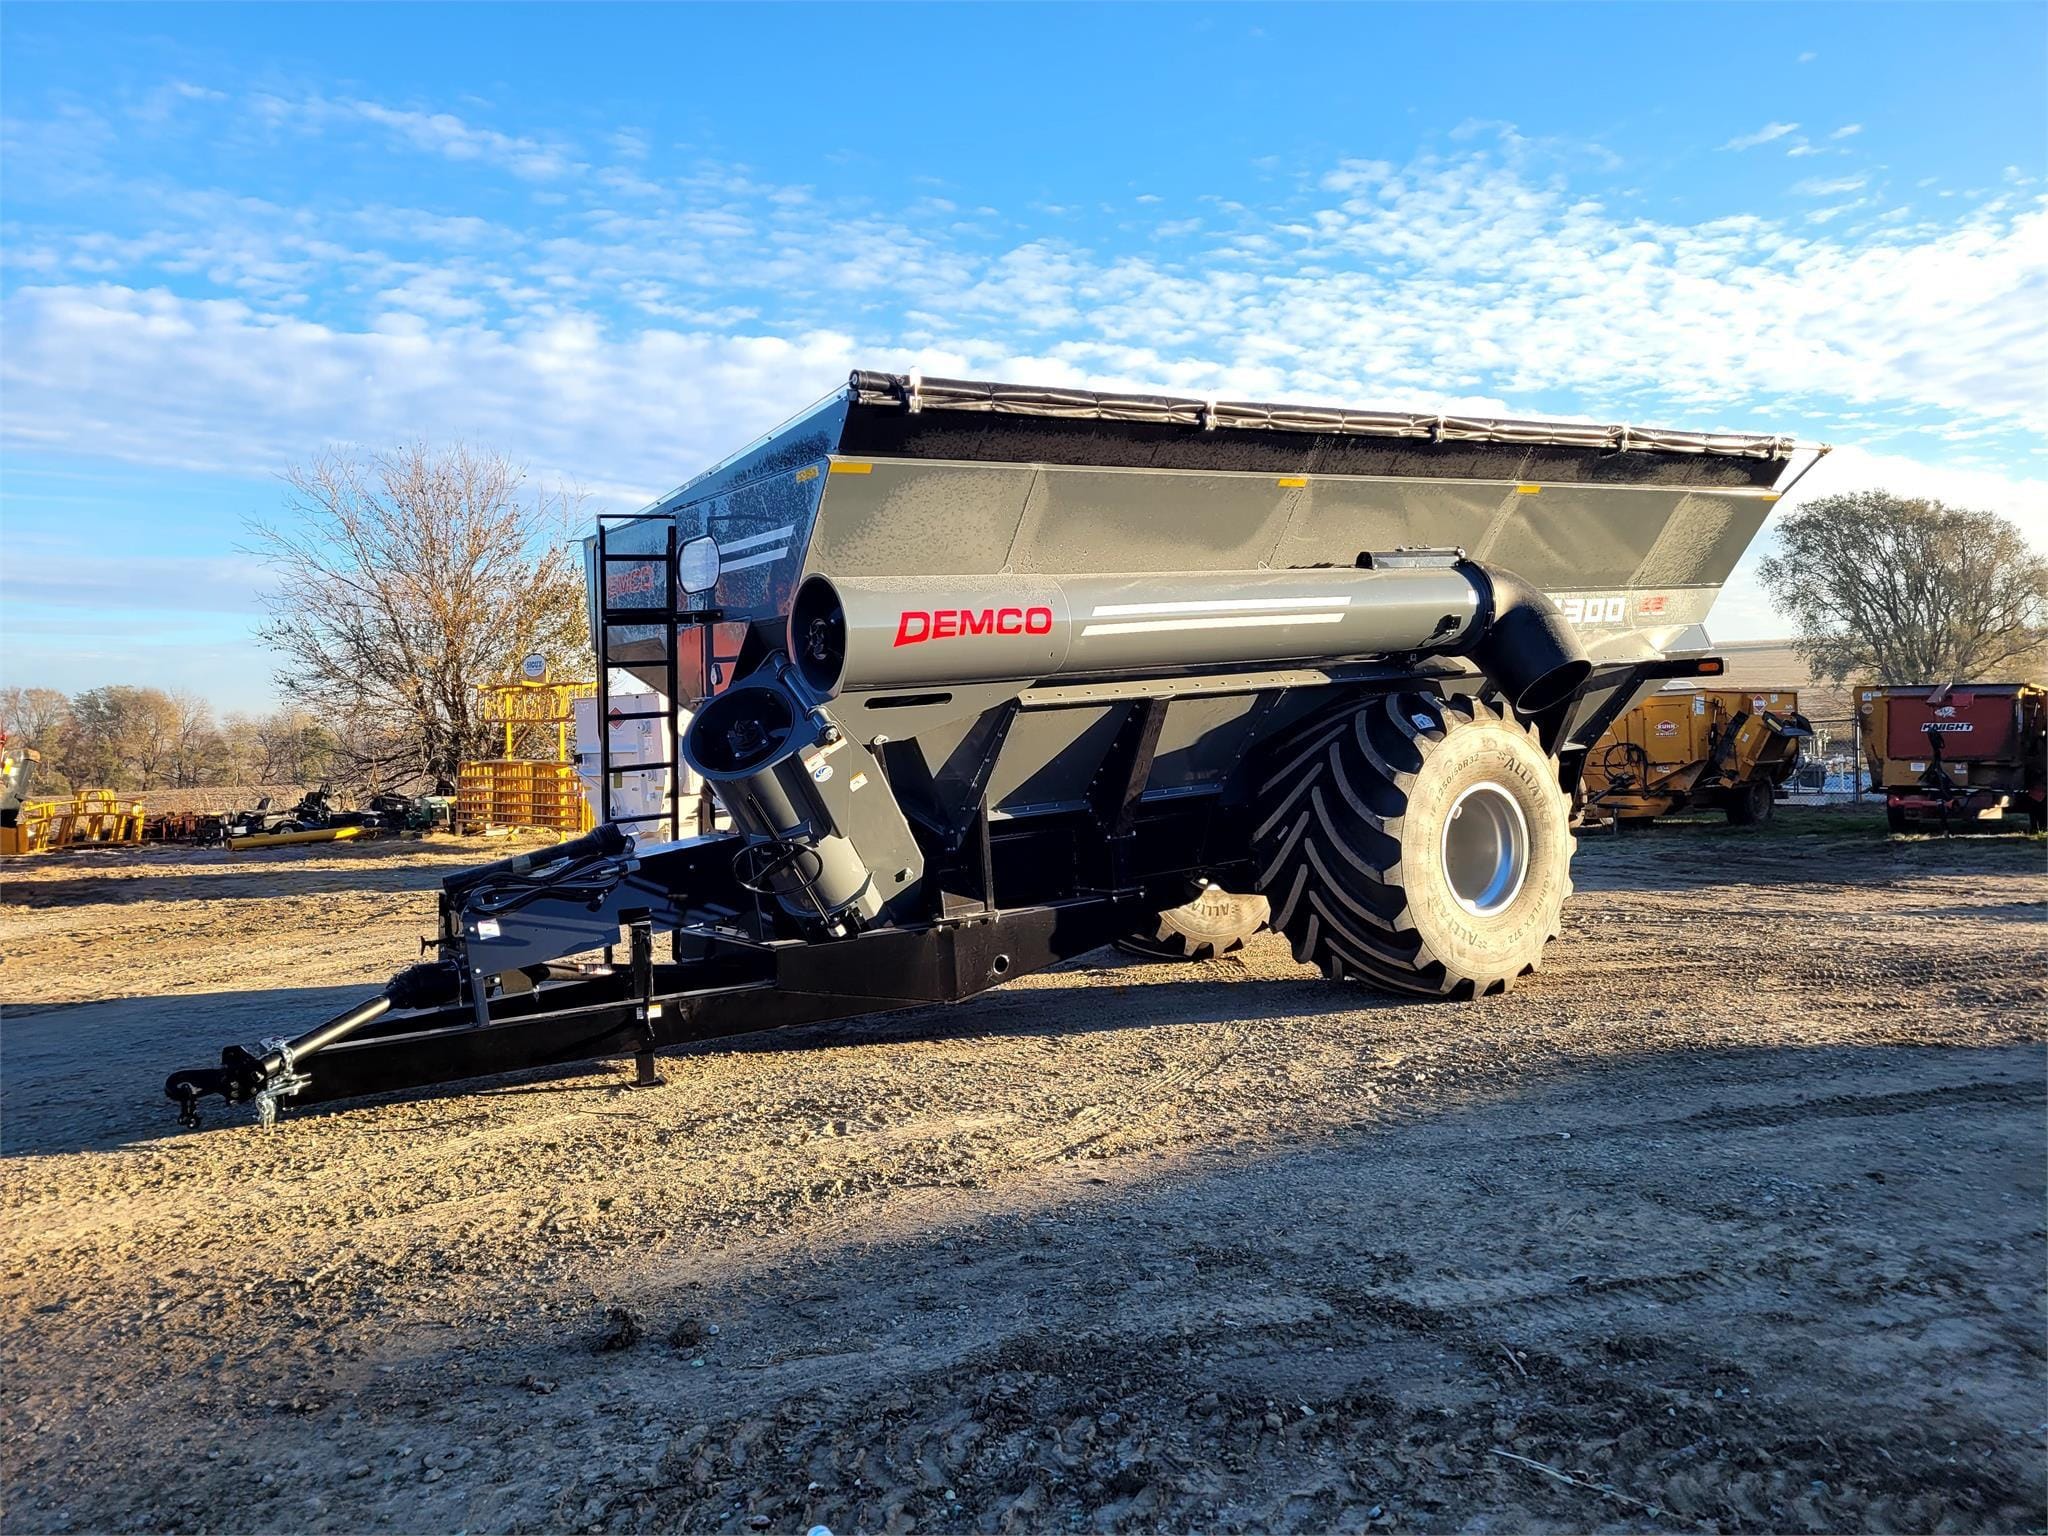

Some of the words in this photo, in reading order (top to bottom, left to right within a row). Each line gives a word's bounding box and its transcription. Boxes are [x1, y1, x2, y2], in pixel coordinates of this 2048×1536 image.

[605, 565, 655, 599] EMCO
[893, 606, 1053, 648] DEMCO
[1921, 722, 1973, 732] KNIGHT
[1507, 929, 1524, 944] 372
